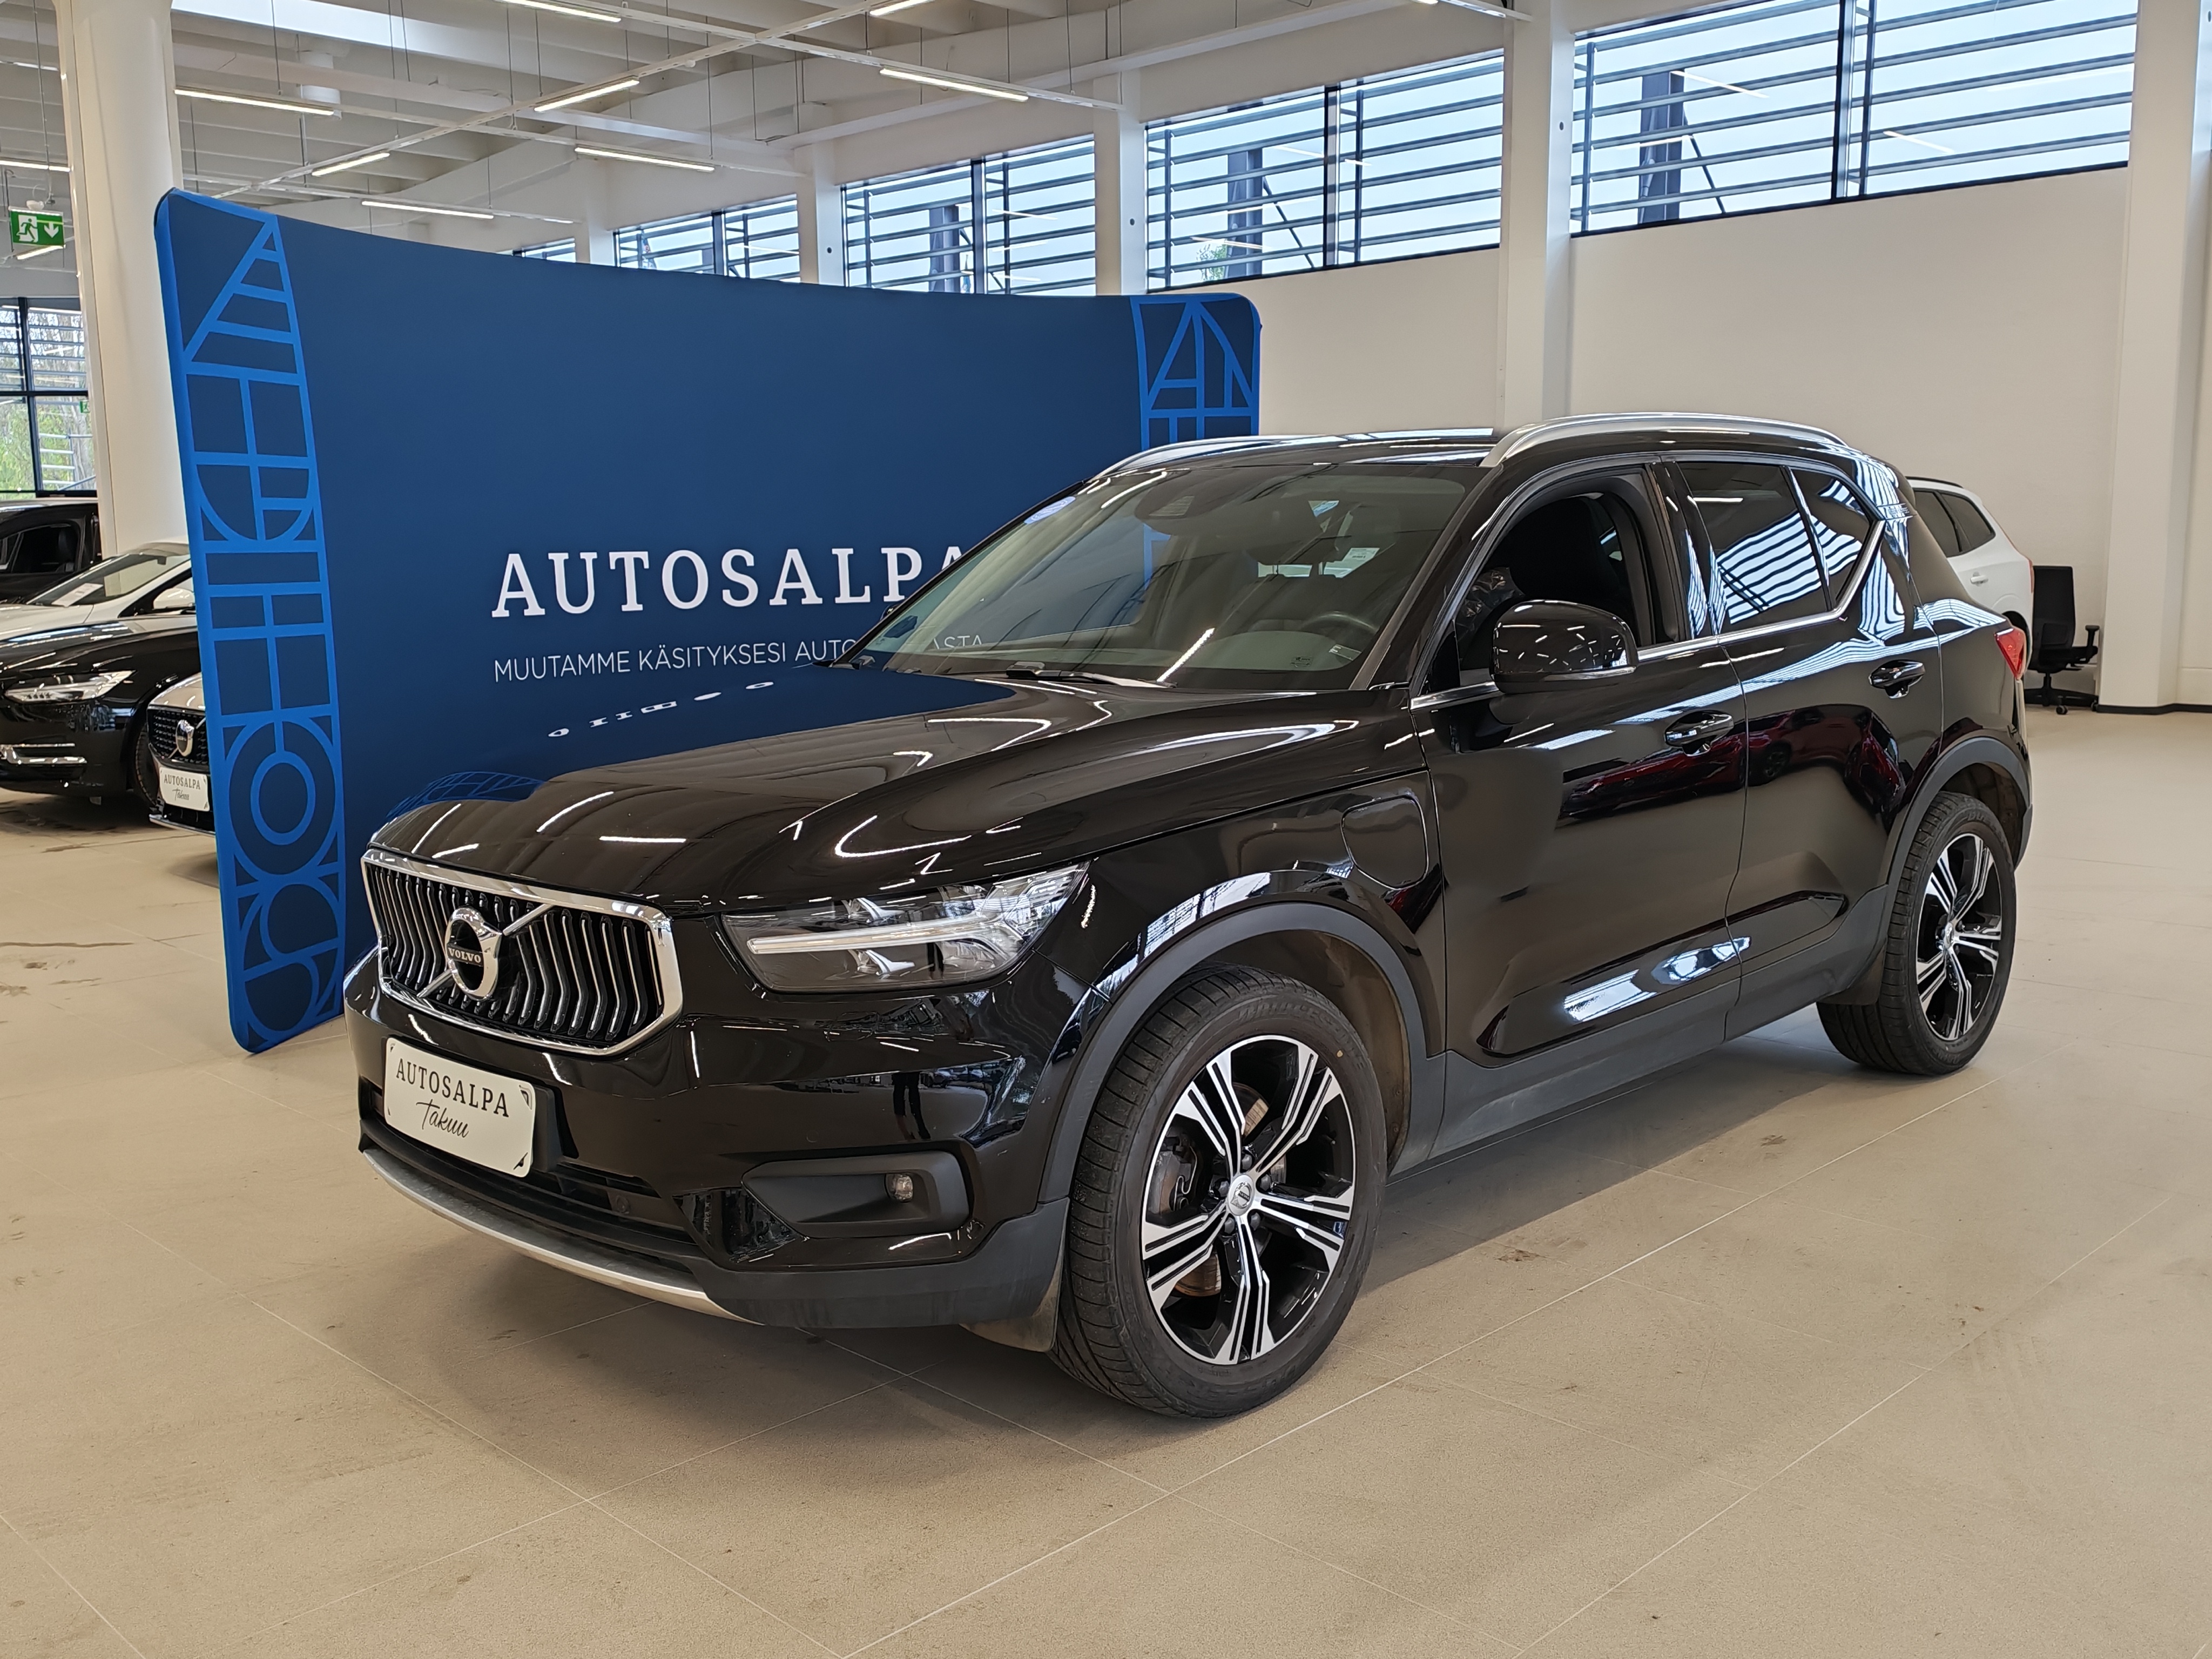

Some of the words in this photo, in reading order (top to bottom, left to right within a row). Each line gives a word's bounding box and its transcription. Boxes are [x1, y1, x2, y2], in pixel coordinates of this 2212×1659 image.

[495, 651, 631, 682] MUUTAMME
[639, 644, 785, 671] KÄSITYKSESI
[164, 774, 200, 790] AUTOSALPA
[448, 947, 481, 963] VOLVO
[396, 1058, 509, 1117] AUTOSALPA
[416, 1099, 469, 1138] Takuu
